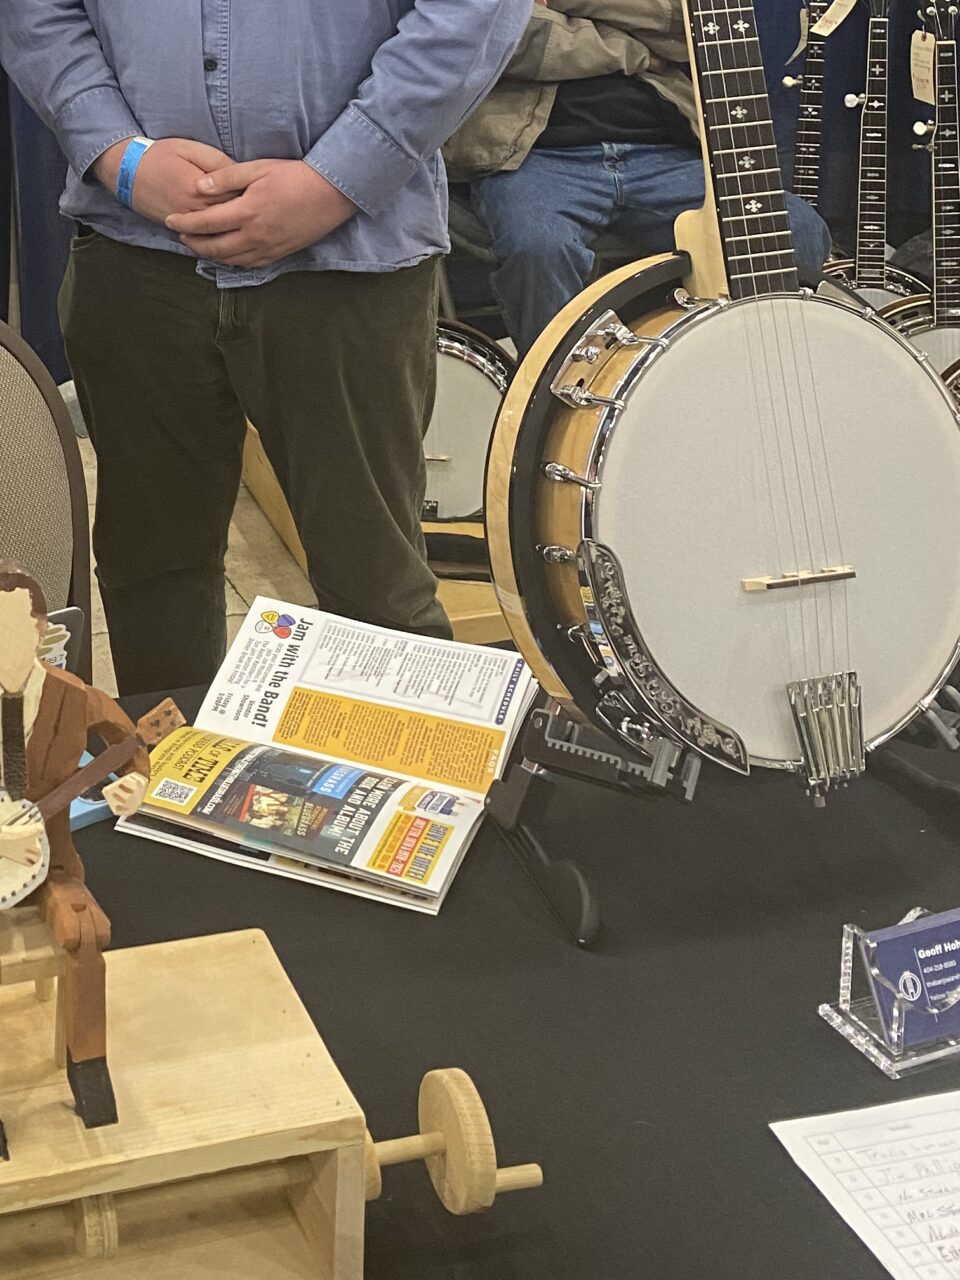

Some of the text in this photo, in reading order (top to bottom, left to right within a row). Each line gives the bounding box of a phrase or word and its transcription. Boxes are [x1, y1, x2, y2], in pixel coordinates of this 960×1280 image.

[251, 617, 313, 727] Jam with the Band!
[220, 692, 233, 708] Friday
[497, 663, 523, 719] DAILY SCHEDULE
[232, 694, 249, 721] Showroom
[242, 700, 255, 718] Vendor
[172, 748, 198, 770] PODCAST
[208, 749, 220, 757] OF
[182, 757, 218, 783] TIME
[347, 789, 366, 805] AND
[362, 788, 385, 808] MORE
[296, 802, 313, 836] BLUEGRASS
[327, 804, 355, 836] ALBUM!
[346, 808, 370, 835] ABOUT
[424, 823, 447, 844] SAVE
[334, 837, 355, 855] THE
[417, 841, 438, 857] THE
[405, 855, 431, 881] DATE!
[918, 943, 943, 959] Geoff
